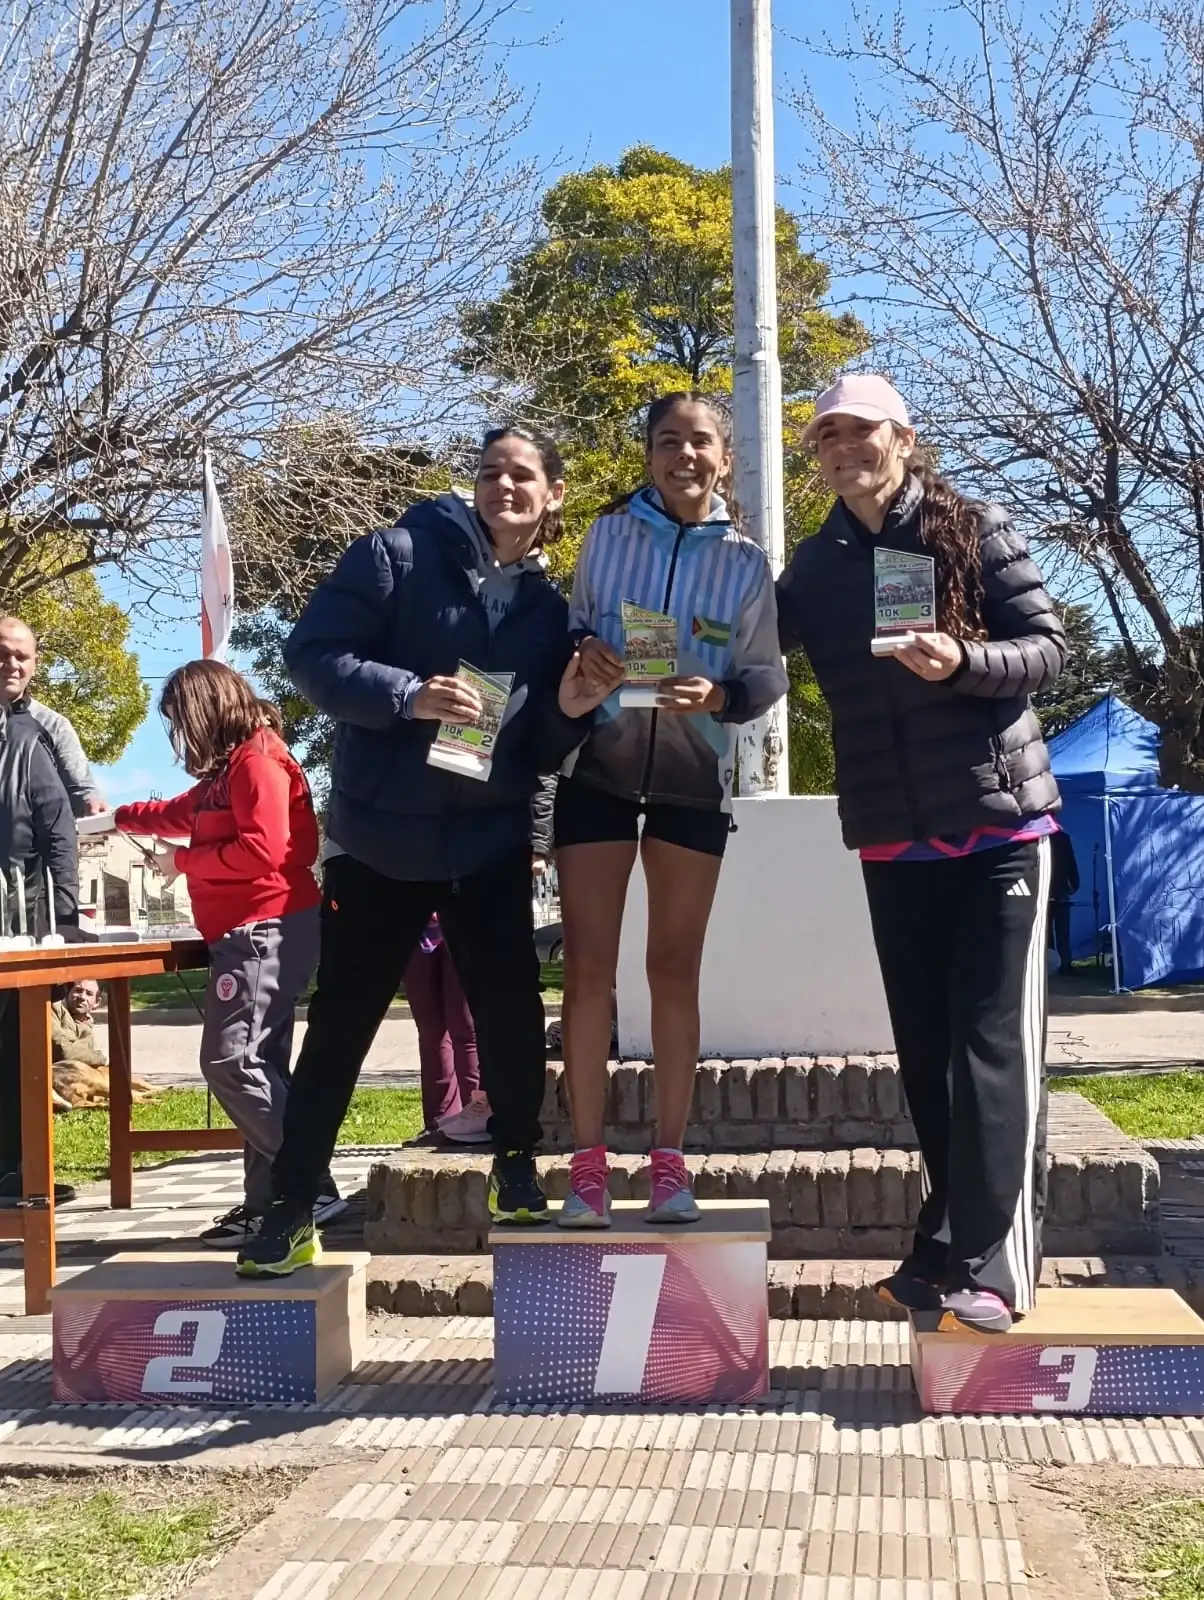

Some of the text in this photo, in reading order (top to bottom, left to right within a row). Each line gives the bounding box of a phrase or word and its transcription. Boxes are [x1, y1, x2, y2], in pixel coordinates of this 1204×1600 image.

[879, 604, 932, 617] 10K 3
[627, 661, 675, 673] 10K 1
[443, 724, 464, 737] 10K
[480, 734, 493, 748] 2
[593, 1254, 667, 1393] 1
[141, 1310, 227, 1393] 2
[1032, 1347, 1098, 1410] 3
